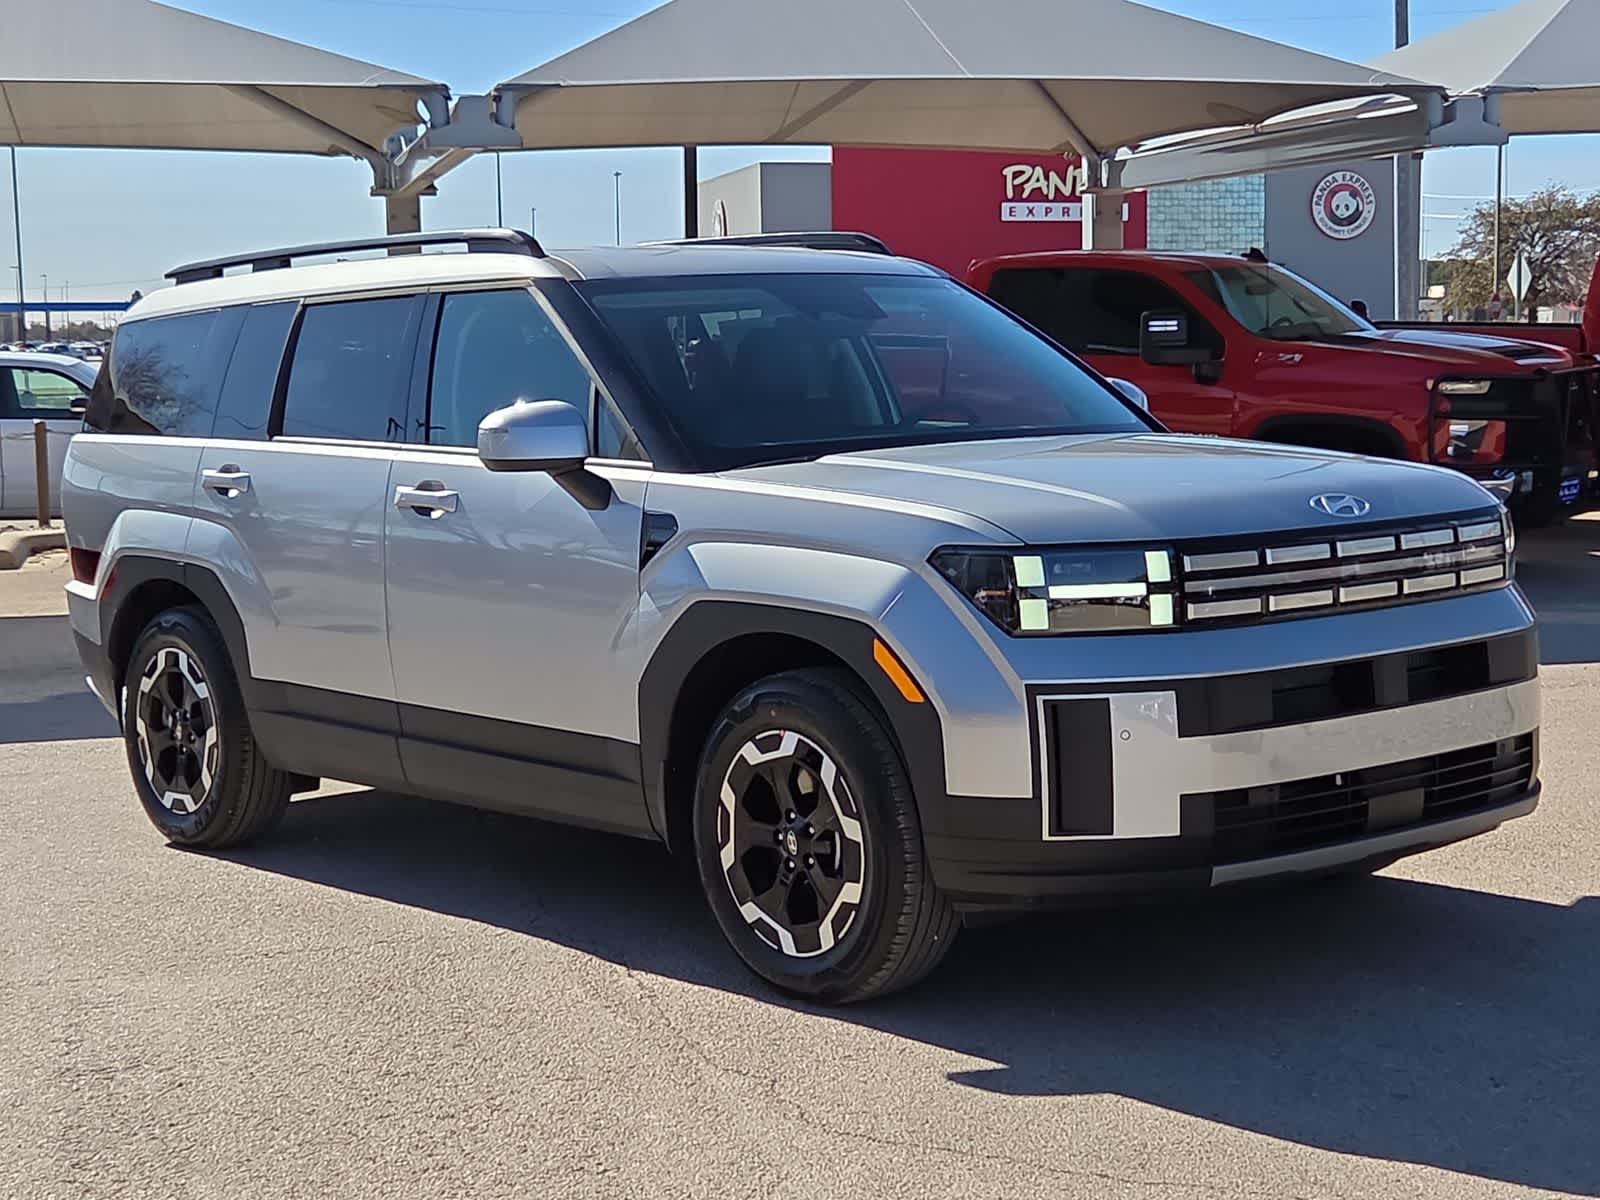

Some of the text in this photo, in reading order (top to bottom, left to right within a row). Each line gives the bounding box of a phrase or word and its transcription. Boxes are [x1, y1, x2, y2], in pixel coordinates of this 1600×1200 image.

[1002, 165, 1082, 200] PAN
[1314, 173, 1374, 207] PANDA EXPRESS
[1008, 206, 1082, 217] EXPR
